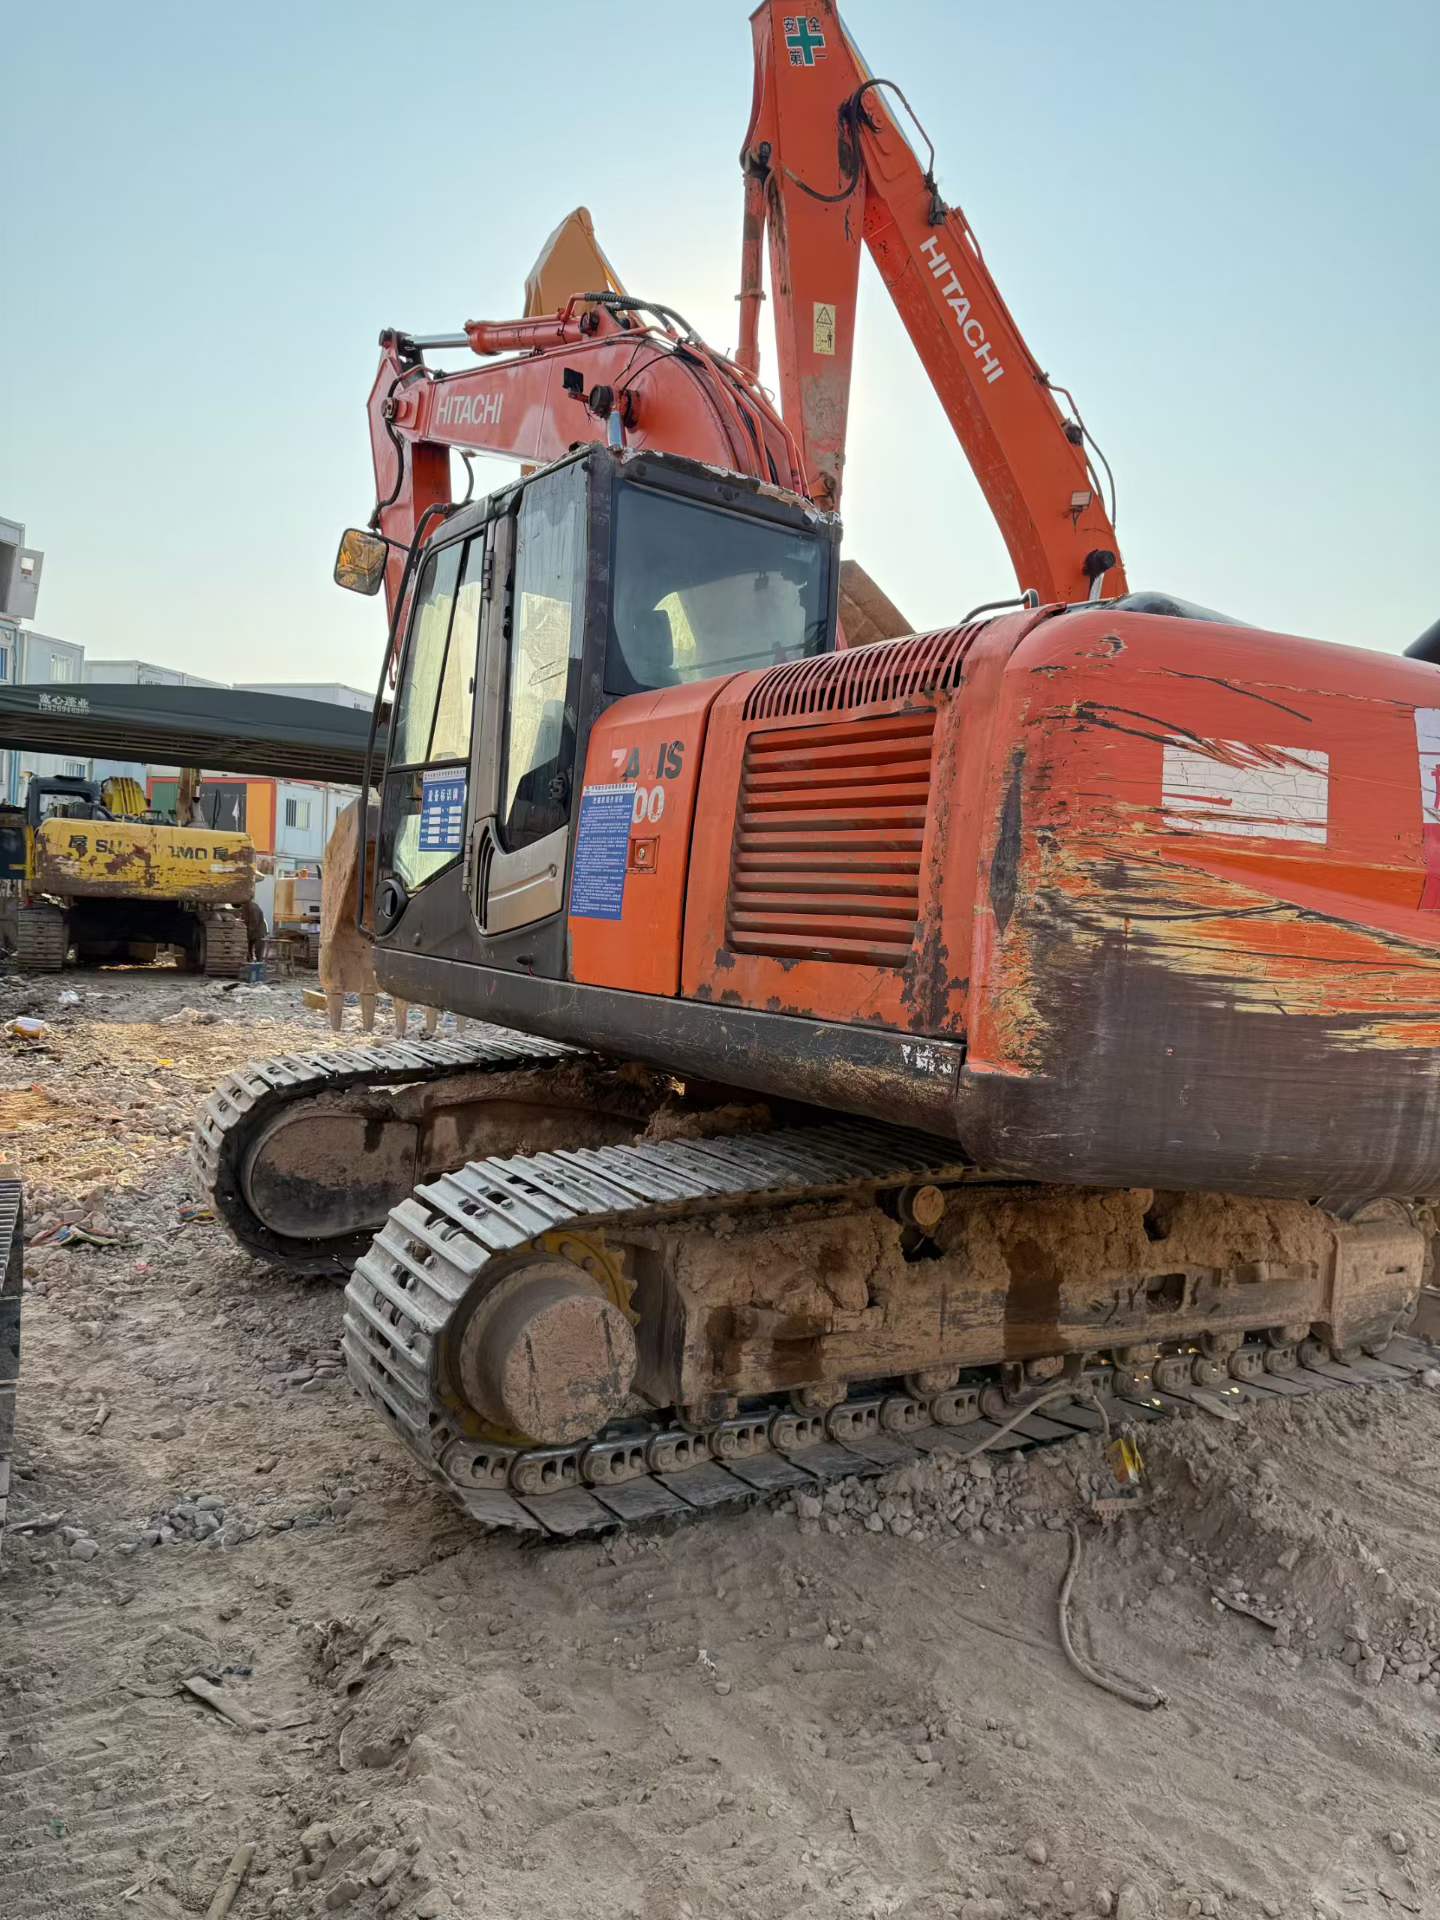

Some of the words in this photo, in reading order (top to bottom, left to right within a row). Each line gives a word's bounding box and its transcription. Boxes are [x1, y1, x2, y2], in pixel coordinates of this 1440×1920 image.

[783, 16, 821, 33] 安全
[789, 48, 827, 65] 第一
[919, 235, 1005, 385] HITACHI
[435, 393, 503, 425] HITACHI
[611, 740, 685, 782] ZAIS
